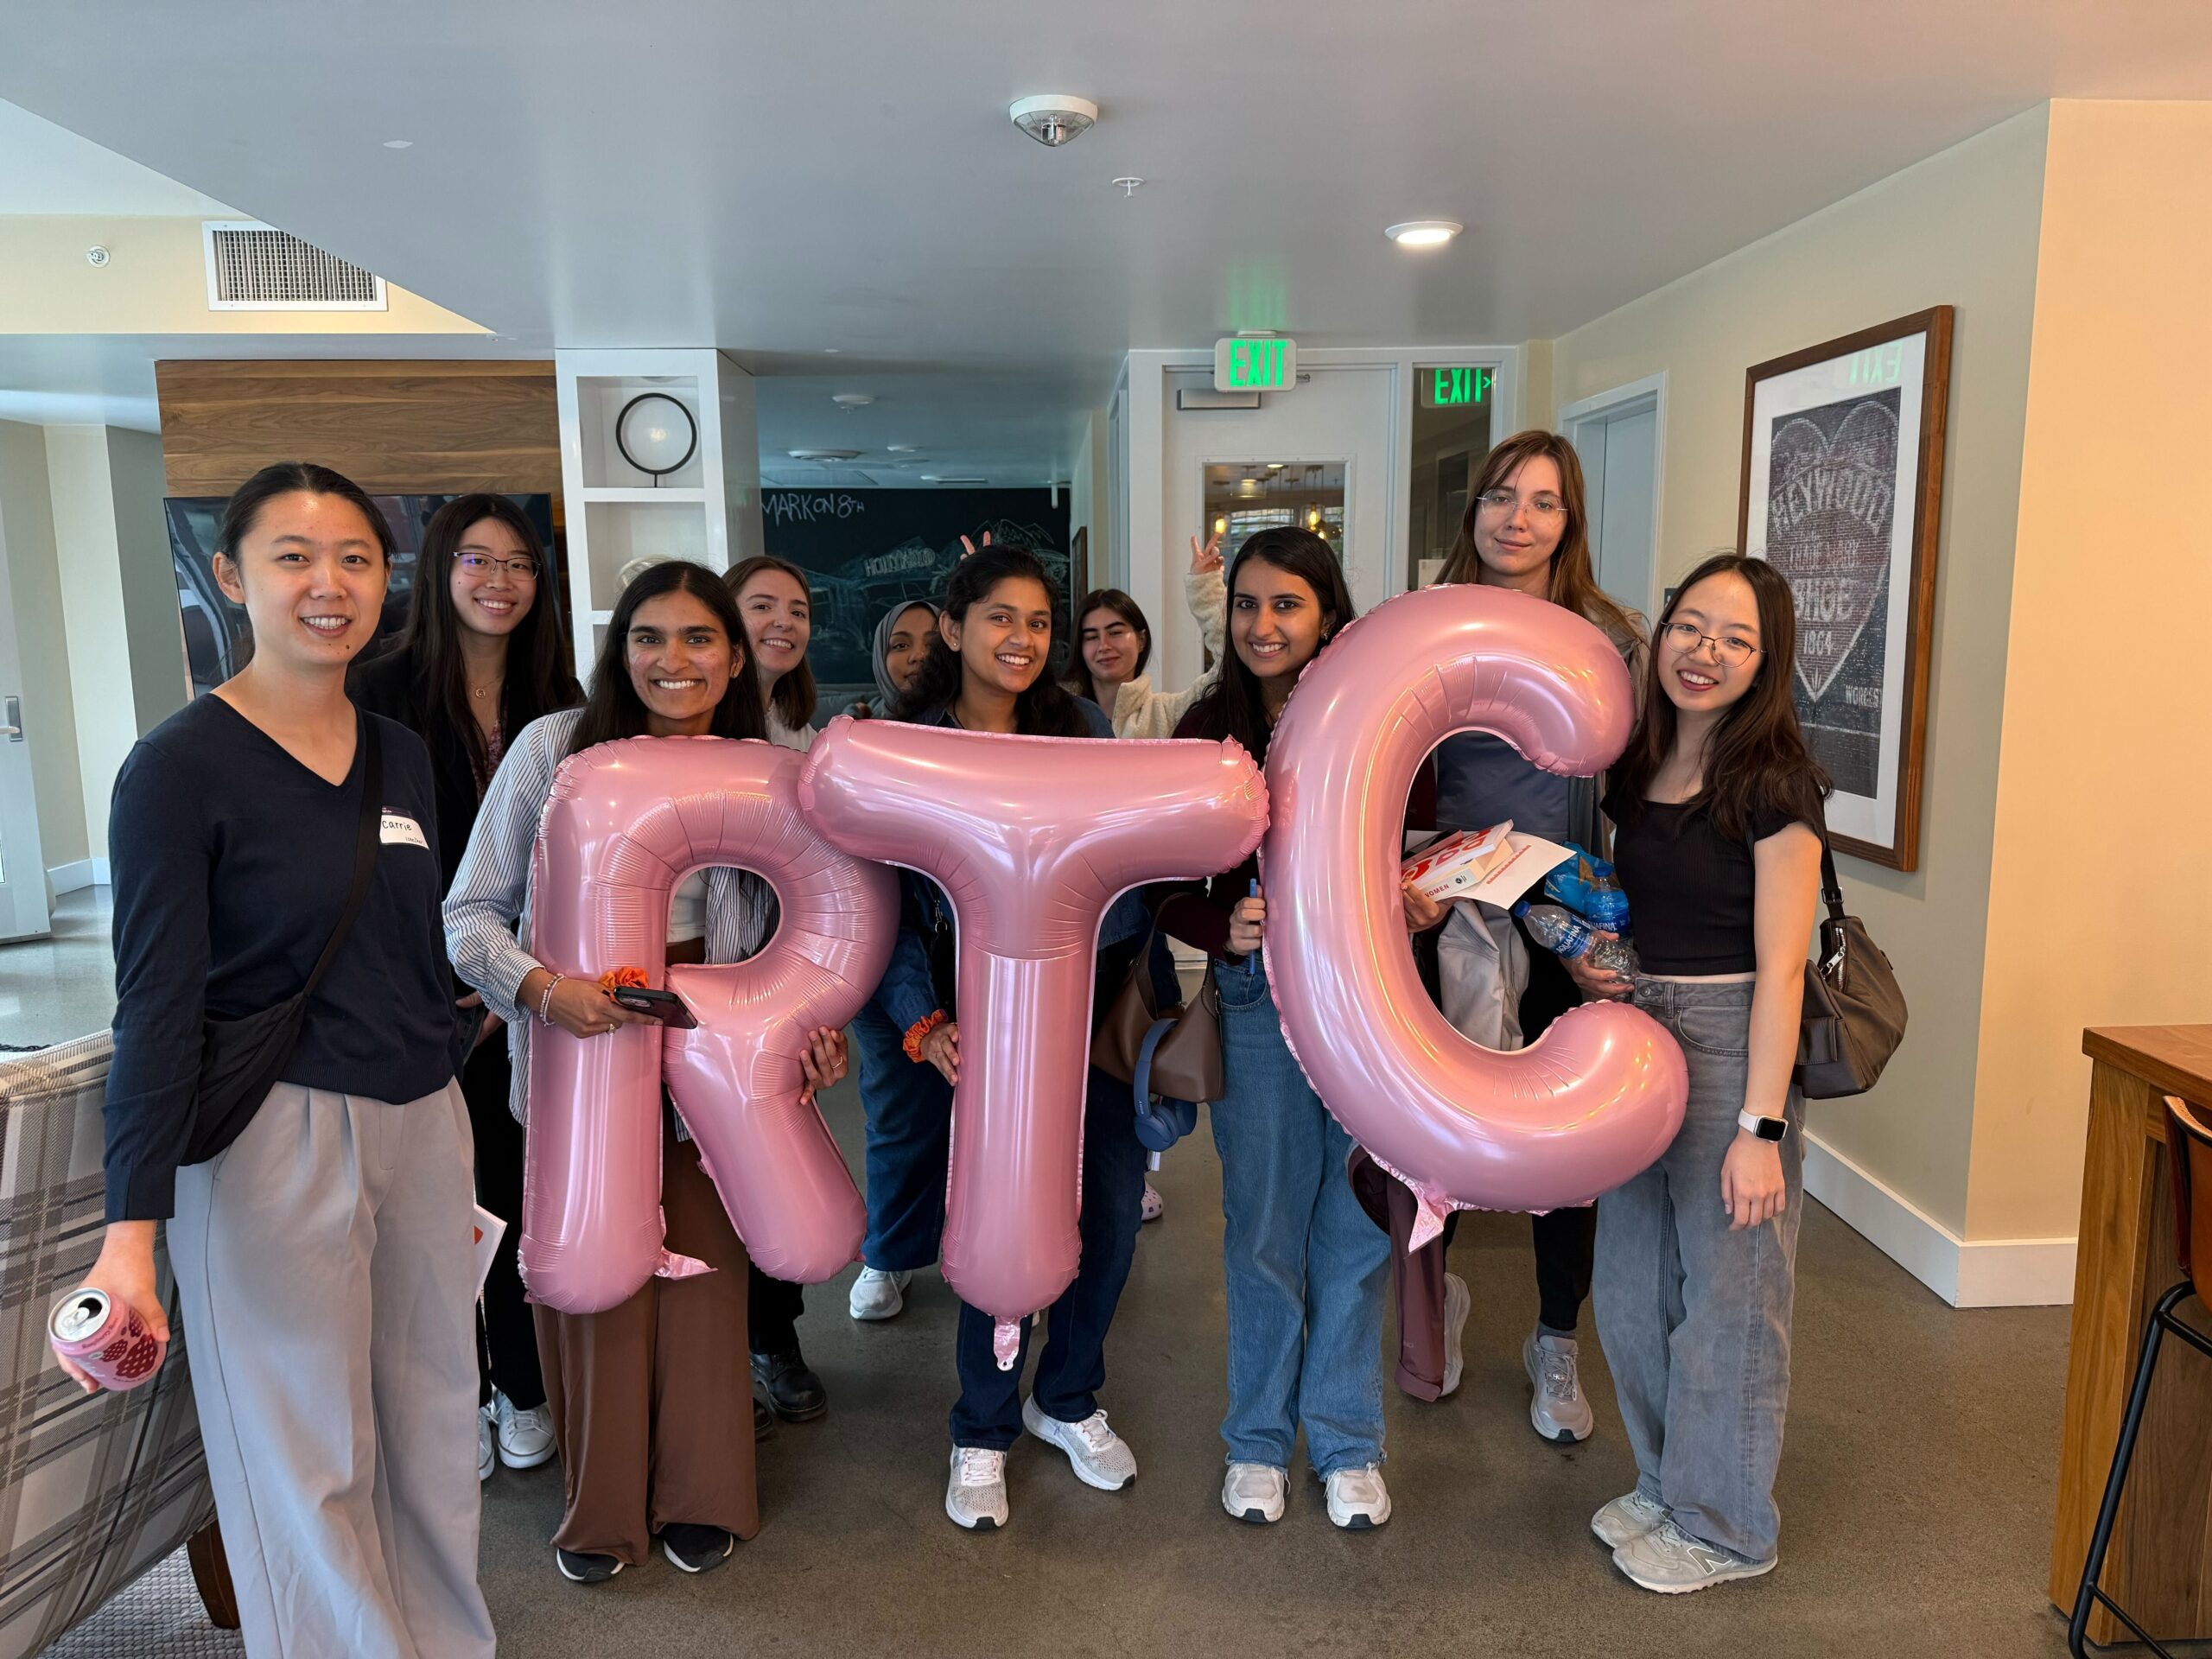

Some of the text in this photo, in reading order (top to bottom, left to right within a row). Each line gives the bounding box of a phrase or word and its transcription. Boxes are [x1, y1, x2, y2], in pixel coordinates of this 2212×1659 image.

[1229, 340, 1287, 387] EXIT
[1434, 368, 1483, 404] EXIT
[761, 493, 817, 527] MARK
[813, 493, 835, 514] ON
[382, 820, 412, 831] Carrie
[1556, 925, 1583, 954] AQUAFINA
